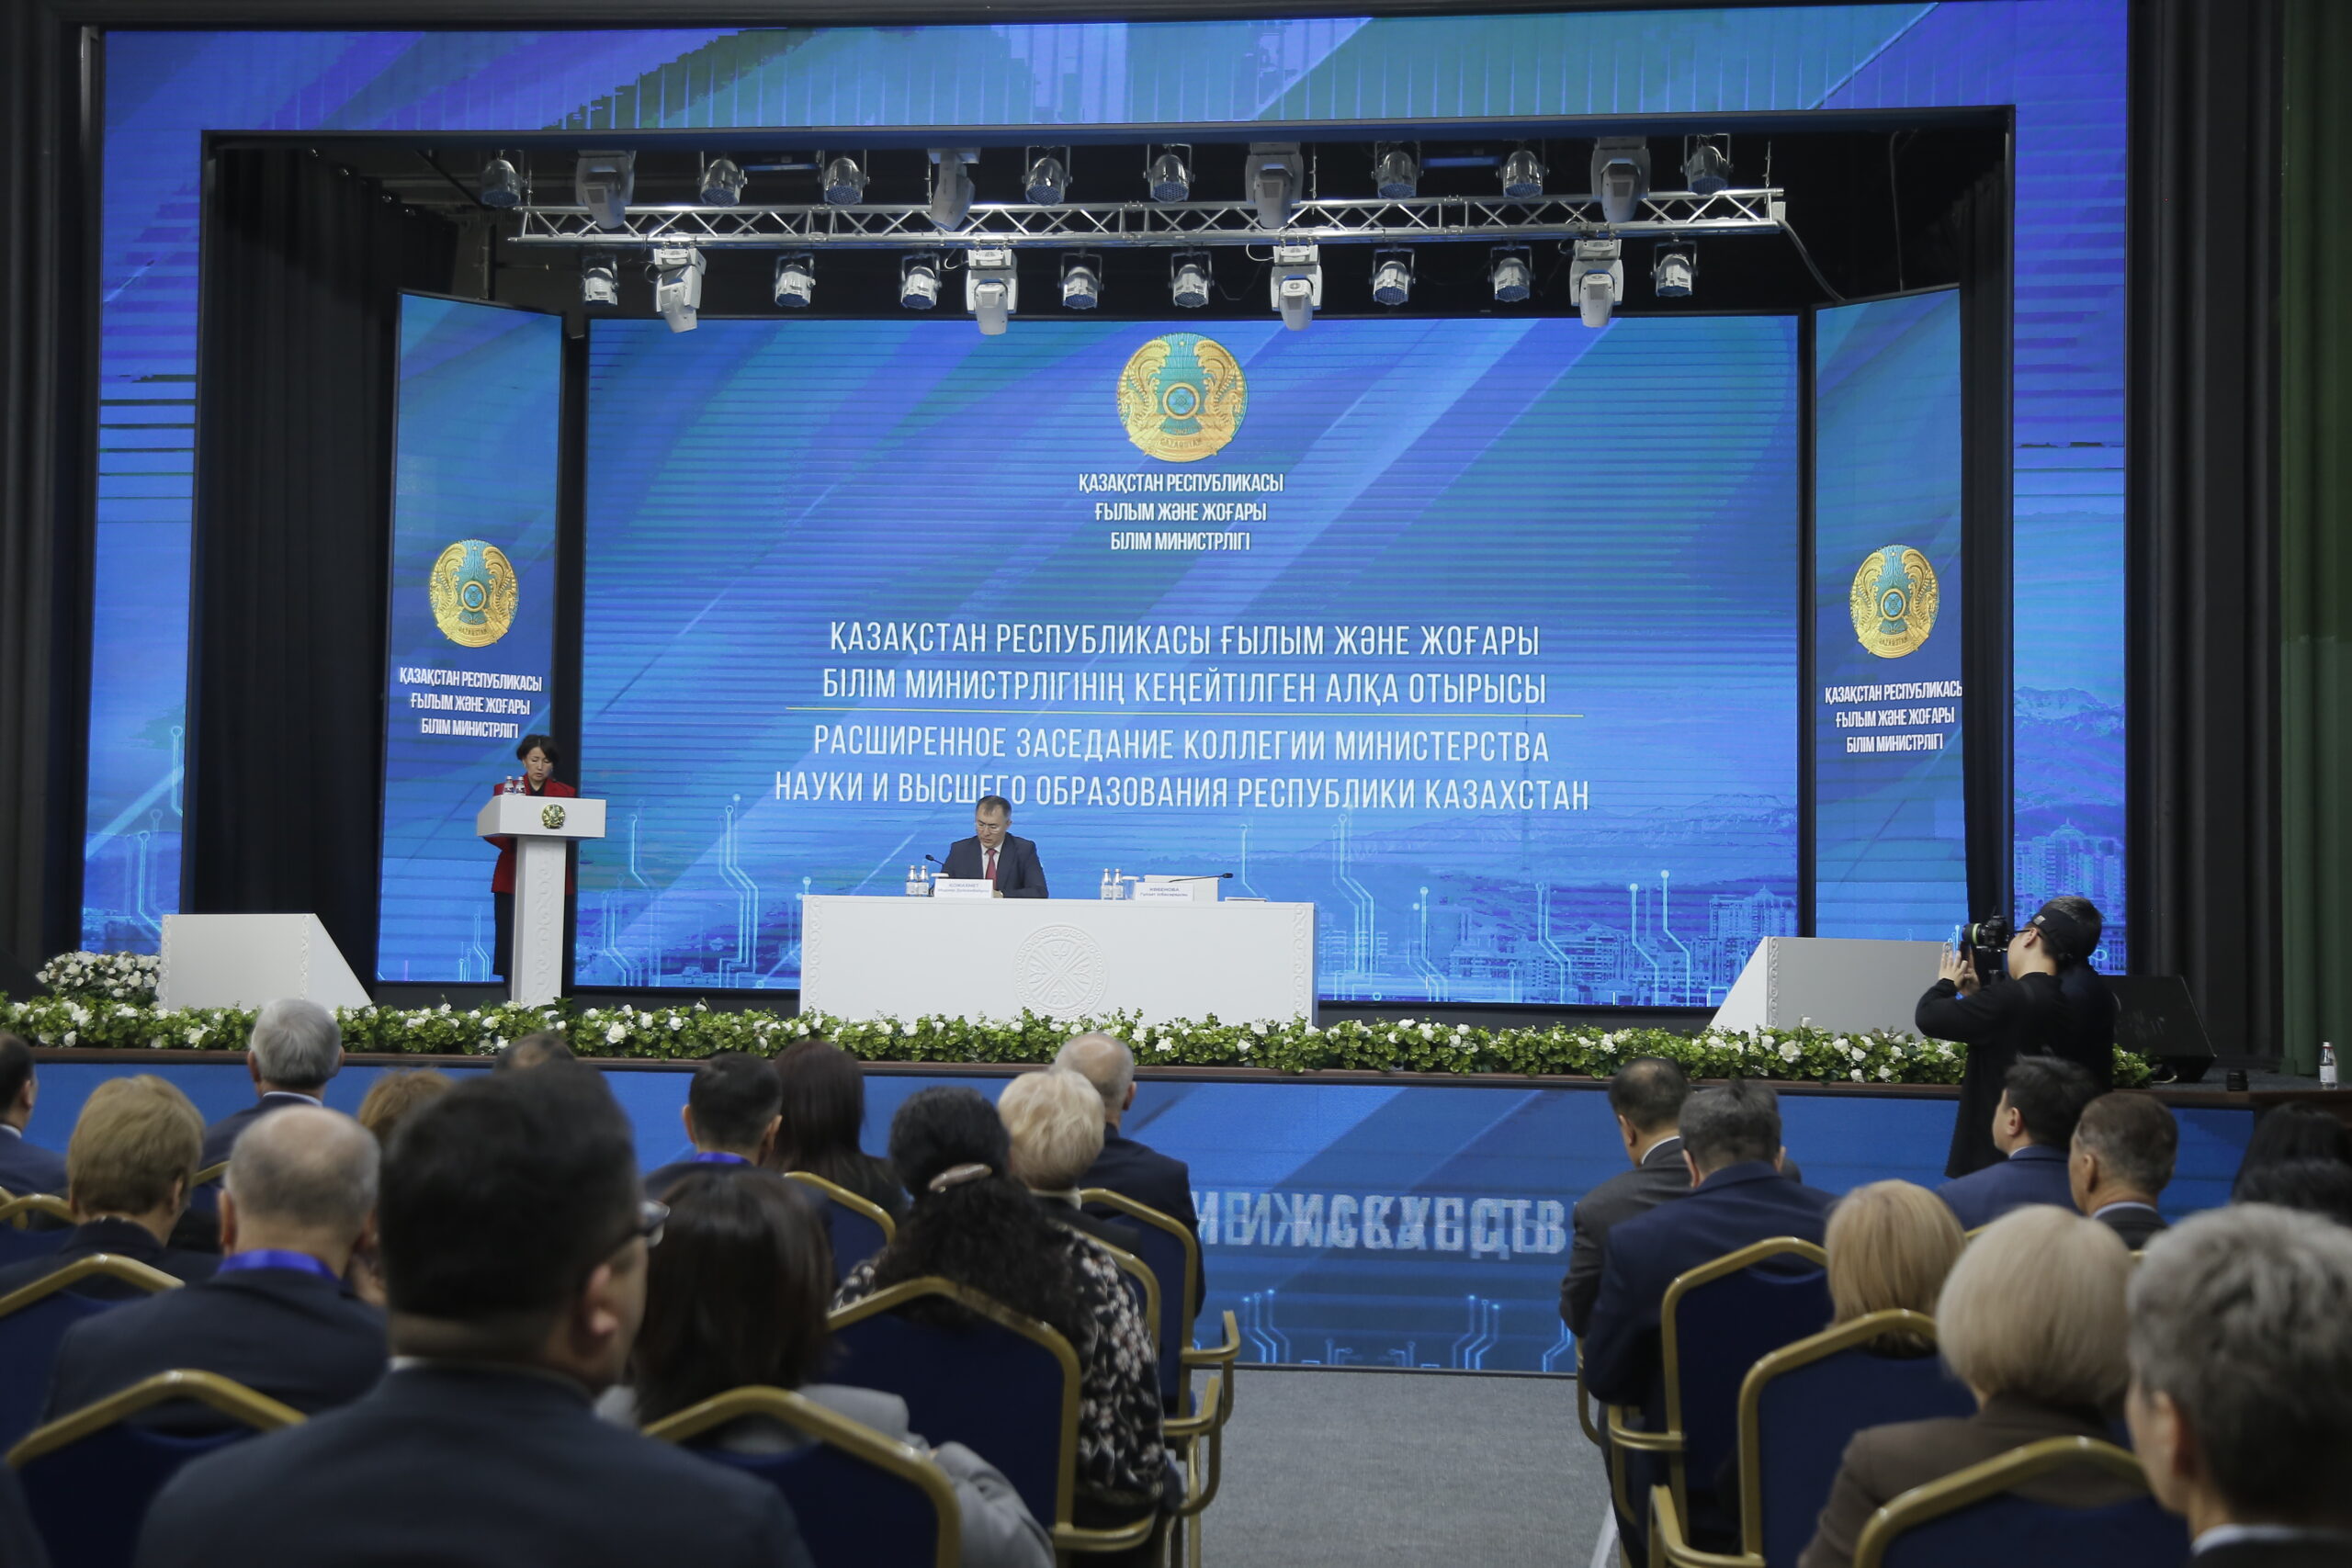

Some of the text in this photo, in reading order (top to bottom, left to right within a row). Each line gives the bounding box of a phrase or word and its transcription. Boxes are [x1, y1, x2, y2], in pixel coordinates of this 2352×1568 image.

[1079, 473, 1283, 494] ҚАЗАҚСТАН РЕСПУБЛИКАСЫ
[1094, 502, 1267, 521] ҒЫЛЫМ ЖӘНЕ ЖОҒАРЫ
[1111, 532, 1250, 550] БІЛІМ МИНИСТРЛІГІ
[831, 621, 1539, 656] ҚАЗАҚСТАН РЕСПУБЛИКАСЫ ҒЫЛЫМ ЖӘНЕ ЖОҒАРЫ
[400, 667, 542, 692] ҚАЗАҚСТАН РЕСПУБЛИКАСЫ
[823, 667, 1545, 706] БІЛІМ МИНИСТРЛІГІНІҢ КЕҢЕЙТІЛГЕН АЛҚА ОТЫРЫСЫ
[410, 692, 530, 716] ҒЫЛЫМ ЖӘНЕ ЖОҒАРЫ
[1825, 684, 1883, 705] ҚАЗАҚСТАН
[421, 717, 518, 739] БІЛІМ МИНИСТРЛІГІ
[1836, 706, 1955, 728] ҒЫЛЫМ ЖӘНЕ ЖОҒАРЫ
[814, 725, 1549, 762] РАСШИРЕННОЕ ЗАСЕДАНИЕ КОЛЛЕГИИ МИНИСТЕРСТВА
[1847, 733, 1943, 753] БІЛІМ МИНИСТРЛІГІ
[775, 771, 1589, 810] НАУКИ И ВЫСШЕГО ОБРАЗОВАНИЯ РЕСПУБЛИКИ КАЗАХСТАН
